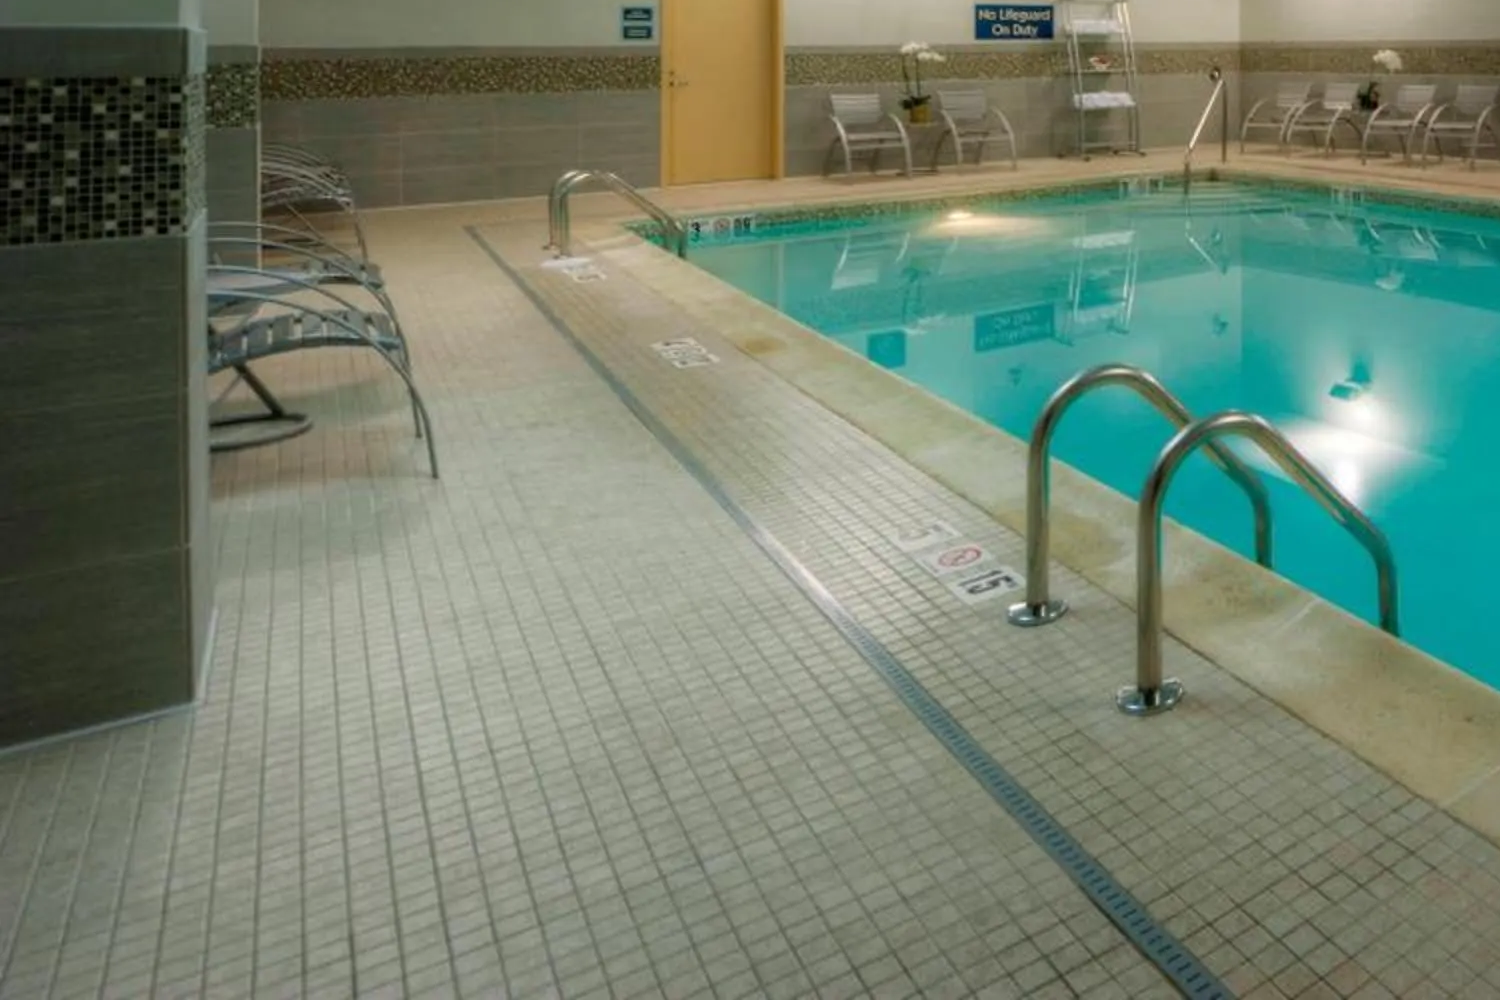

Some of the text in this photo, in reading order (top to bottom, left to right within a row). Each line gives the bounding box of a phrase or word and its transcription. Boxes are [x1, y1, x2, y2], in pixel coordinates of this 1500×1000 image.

[979, 8, 1050, 22] No Lifeguard
[992, 23, 1038, 37] On Duty
